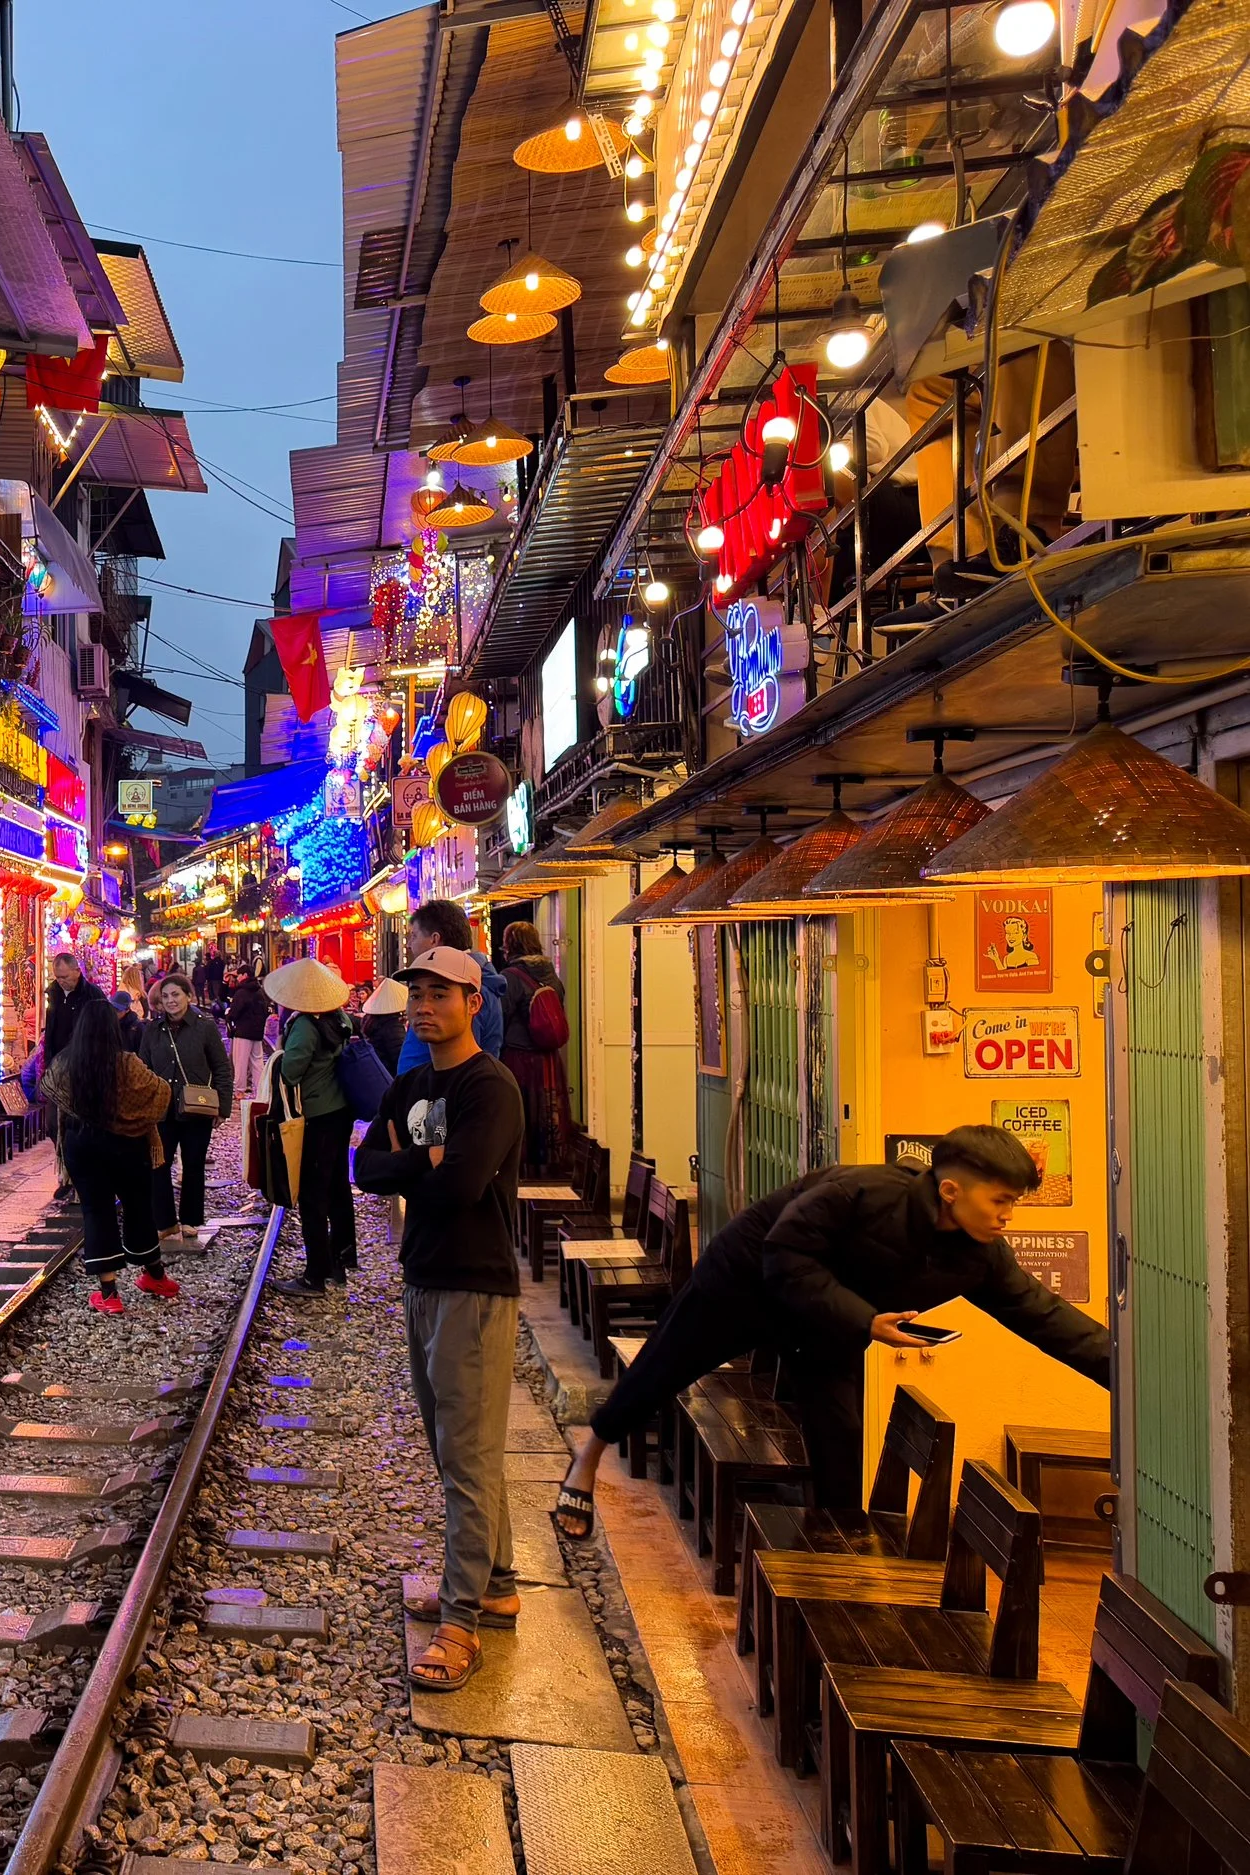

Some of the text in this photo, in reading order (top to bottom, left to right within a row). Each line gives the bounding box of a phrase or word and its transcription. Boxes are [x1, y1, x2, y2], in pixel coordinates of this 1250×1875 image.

[453, 799, 498, 814] BÁN HÀNG
[981, 900, 1048, 913] VODKA!
[972, 1015, 1067, 1039] Come in WE'RE
[975, 1039, 1073, 1070] OPEN
[1015, 1106, 1048, 1119] ICED
[1002, 1119, 1063, 1132] COFFEE
